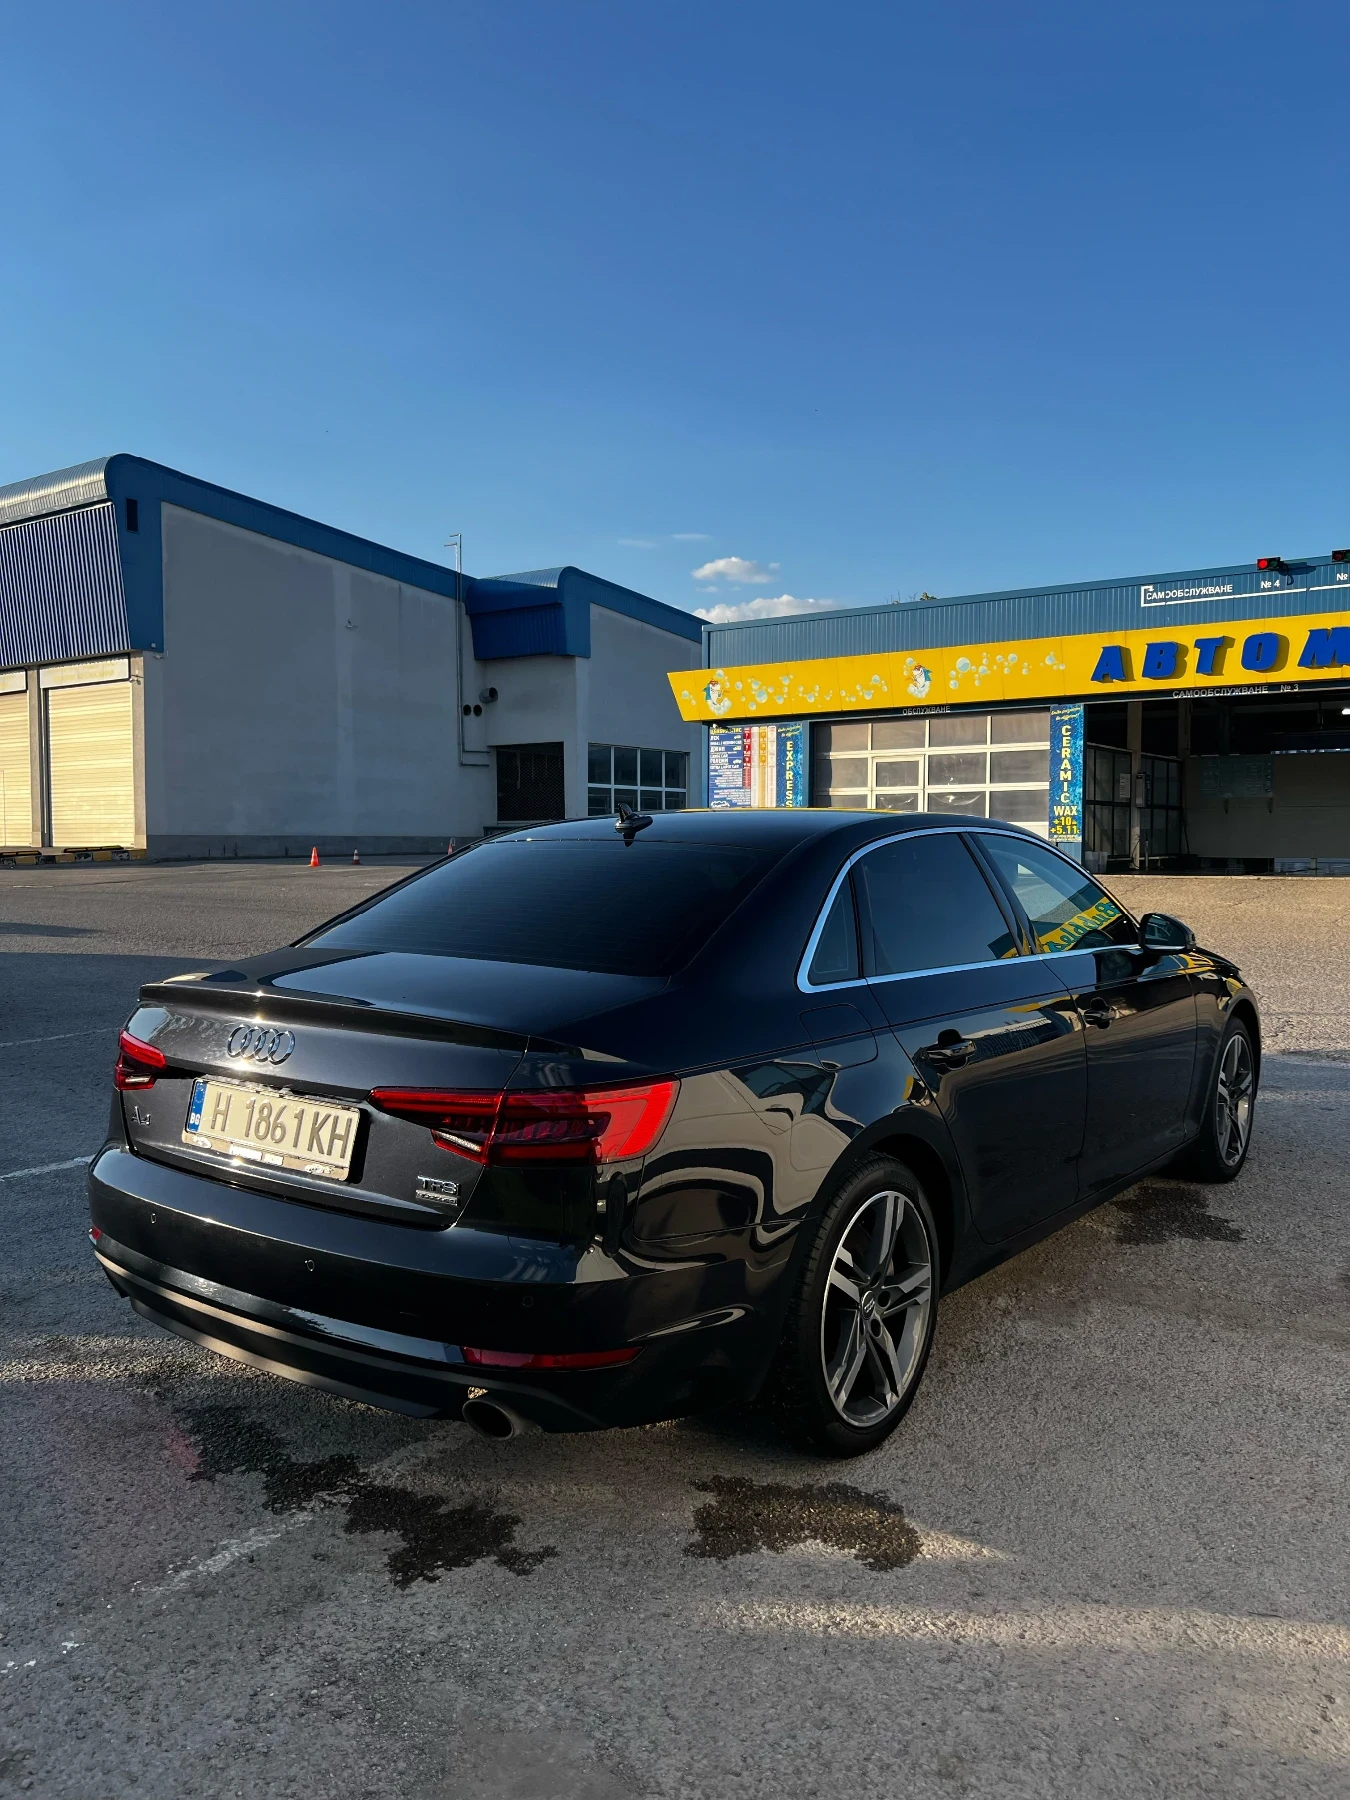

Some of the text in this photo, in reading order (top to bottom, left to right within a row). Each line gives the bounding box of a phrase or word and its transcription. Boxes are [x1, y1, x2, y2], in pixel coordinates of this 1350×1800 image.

[1146, 579, 1280, 600] САМООБСЛУЖВАНЕ № 4
[1090, 626, 1350, 682] АВТОМ
[1172, 685, 1269, 698] САМООБСЛУЖВАНЕ
[1293, 683, 1299, 692] 3
[902, 705, 951, 716] ОБСЛУЖВАНЕ
[785, 741, 794, 808] EXPRESS
[1059, 725, 1072, 804] CERAMIC
[1054, 805, 1078, 816] WAX
[189, 1112, 201, 1126] BG
[210, 1091, 233, 1132] H
